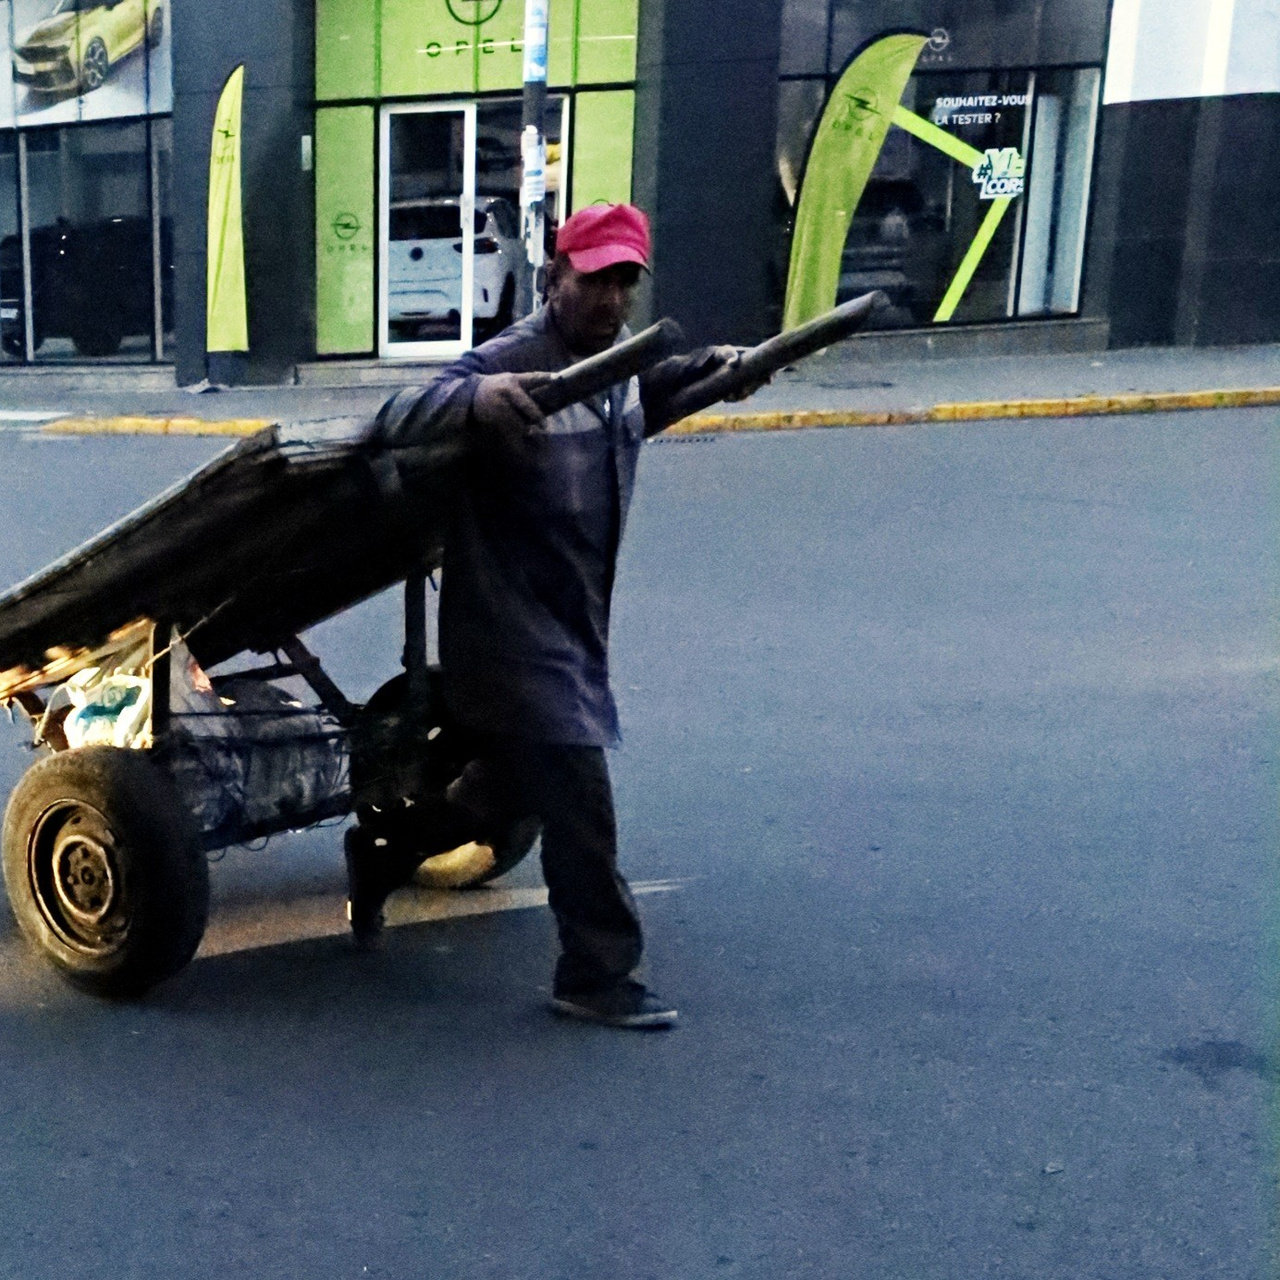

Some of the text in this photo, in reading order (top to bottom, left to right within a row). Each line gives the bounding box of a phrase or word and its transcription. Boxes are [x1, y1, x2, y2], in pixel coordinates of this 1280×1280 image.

[426, 37, 522, 57] OPEL
[935, 94, 1032, 107] SOUHAITEZ-VOUS
[934, 112, 1001, 125] LA TESTER ?
